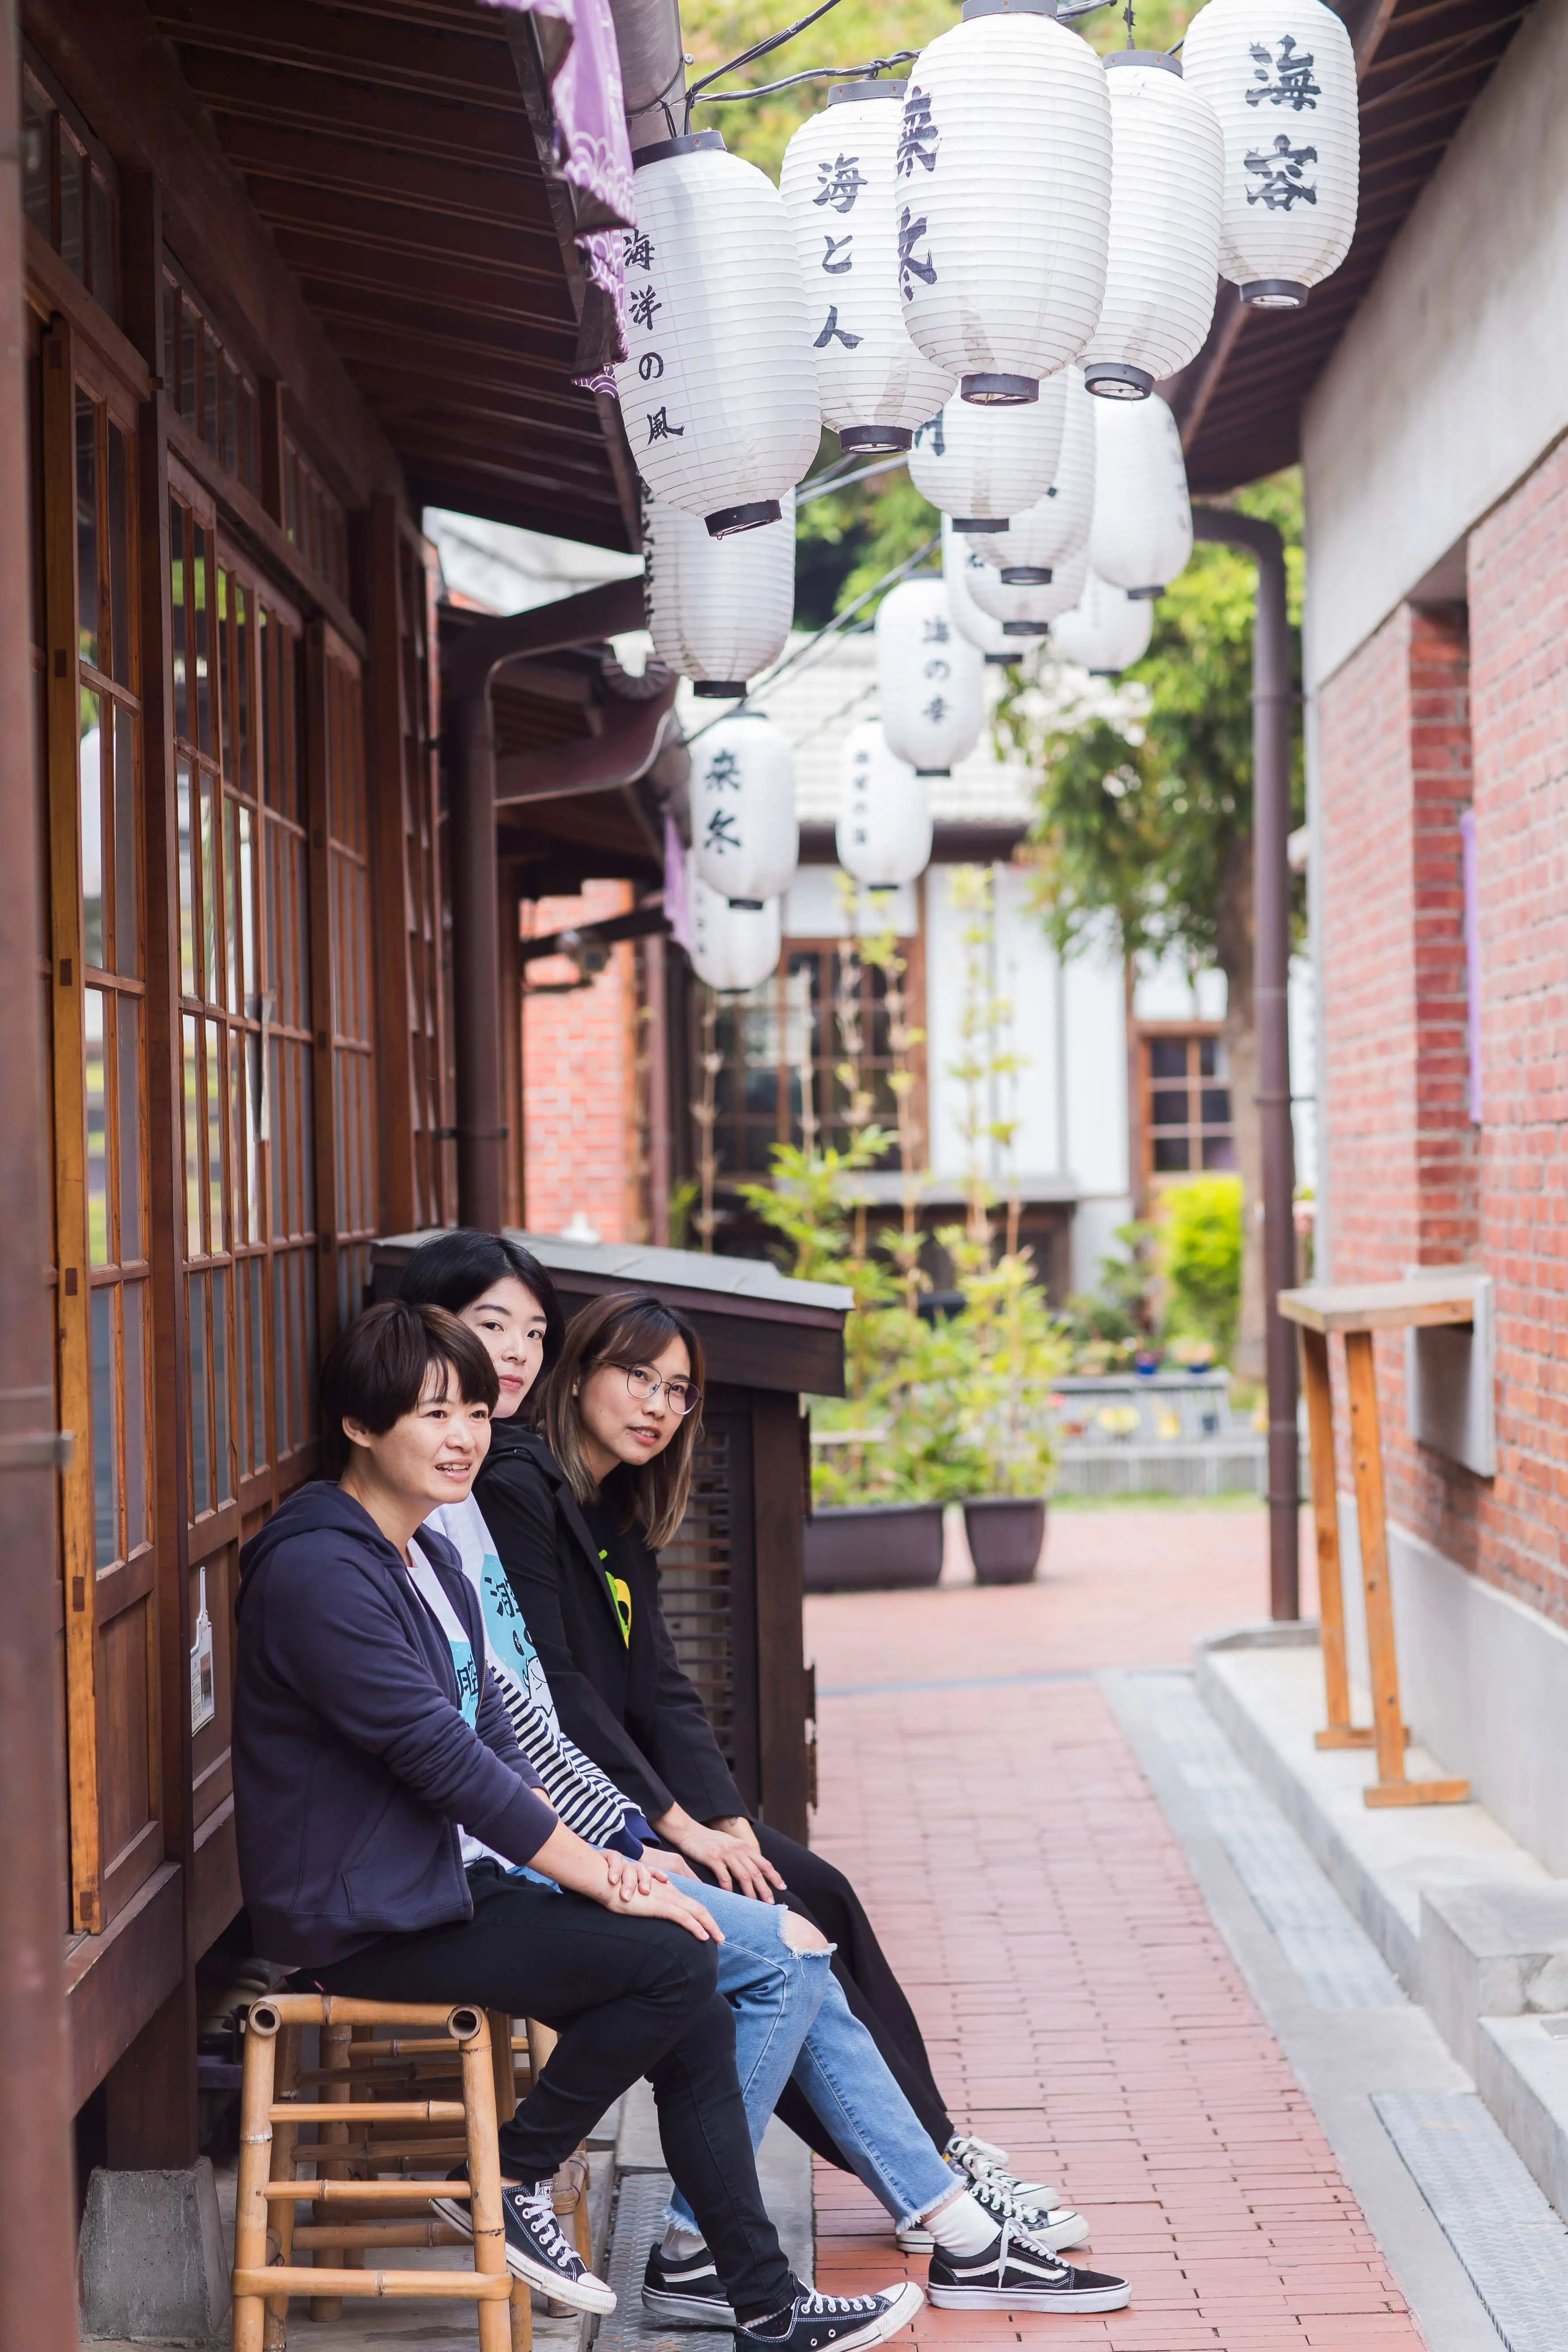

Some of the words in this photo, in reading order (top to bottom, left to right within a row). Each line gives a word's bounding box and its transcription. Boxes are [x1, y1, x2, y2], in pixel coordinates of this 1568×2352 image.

[623, 228, 684, 445] 海洋の風
[812, 152, 868, 350] 海と人
